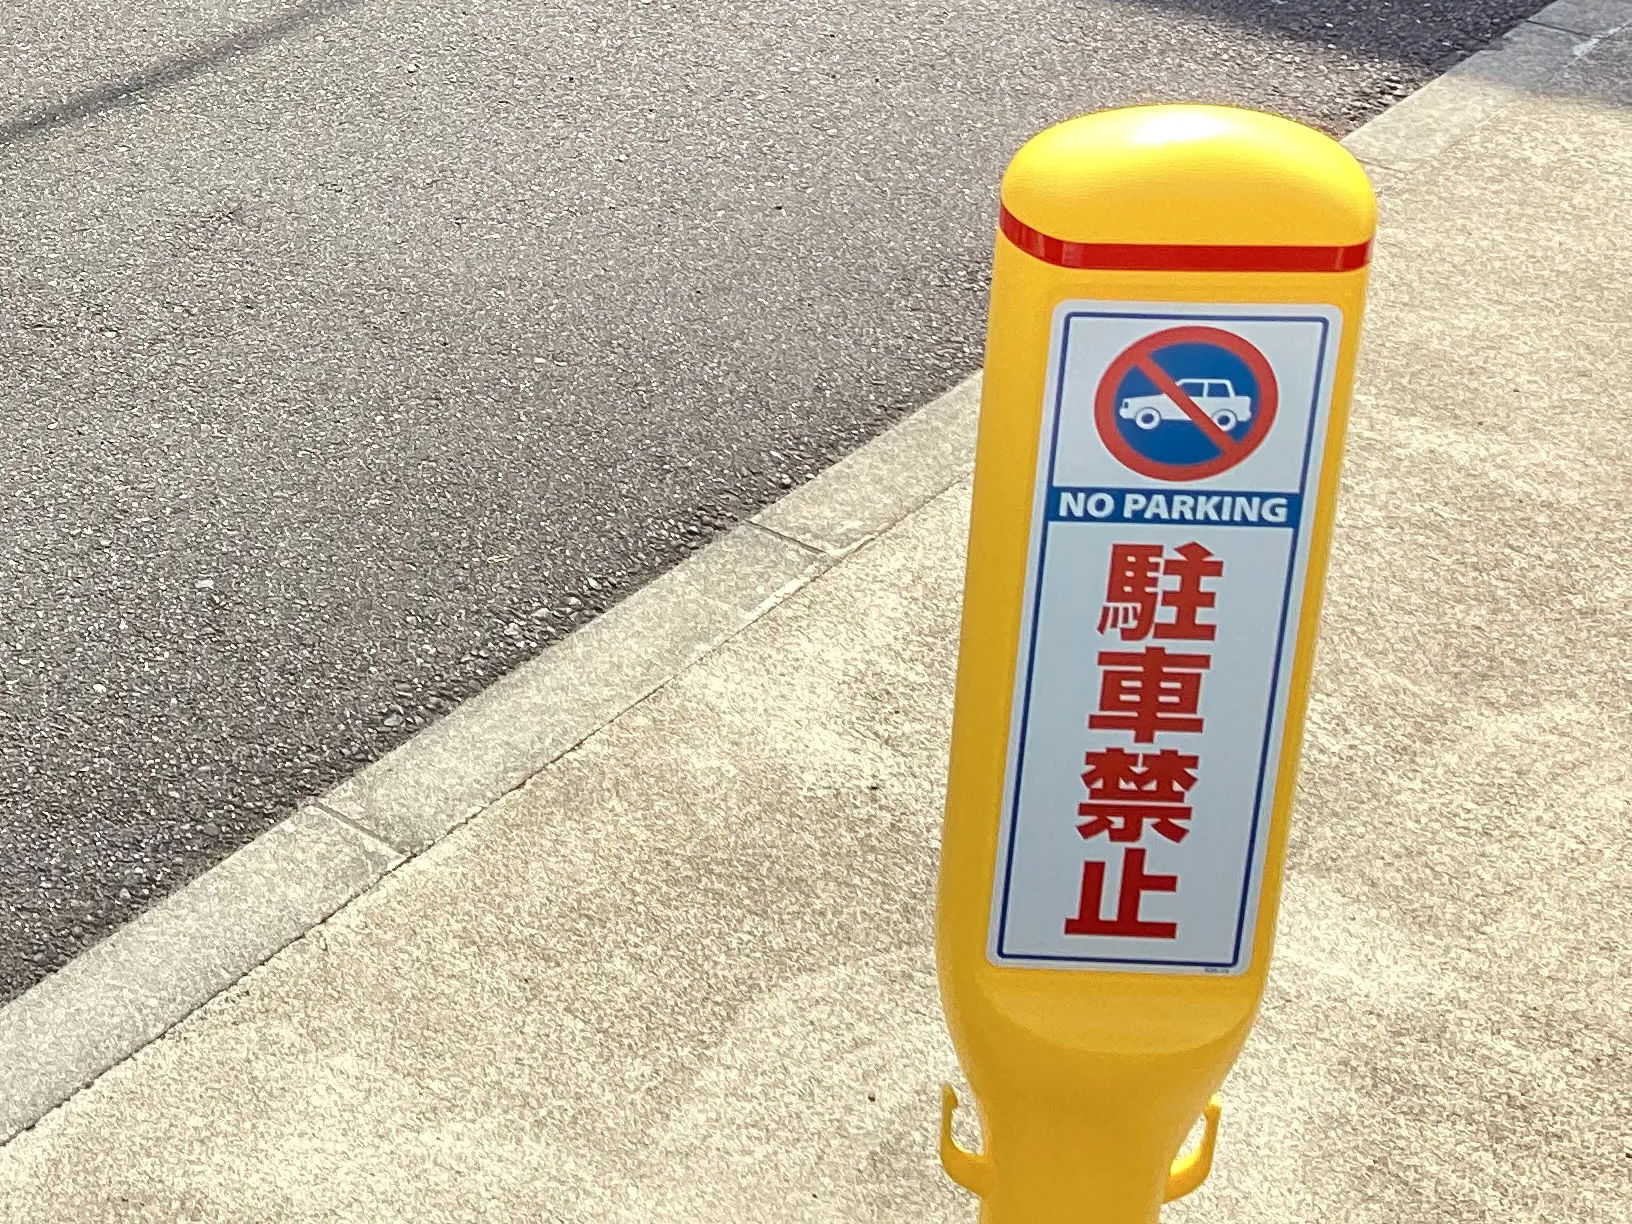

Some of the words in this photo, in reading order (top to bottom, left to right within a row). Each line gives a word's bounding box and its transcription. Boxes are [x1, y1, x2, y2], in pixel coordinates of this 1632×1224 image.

[1058, 491, 1116, 519] NO
[1122, 492, 1290, 523] PARKING
[1063, 541, 1225, 939] 駐車禁止
